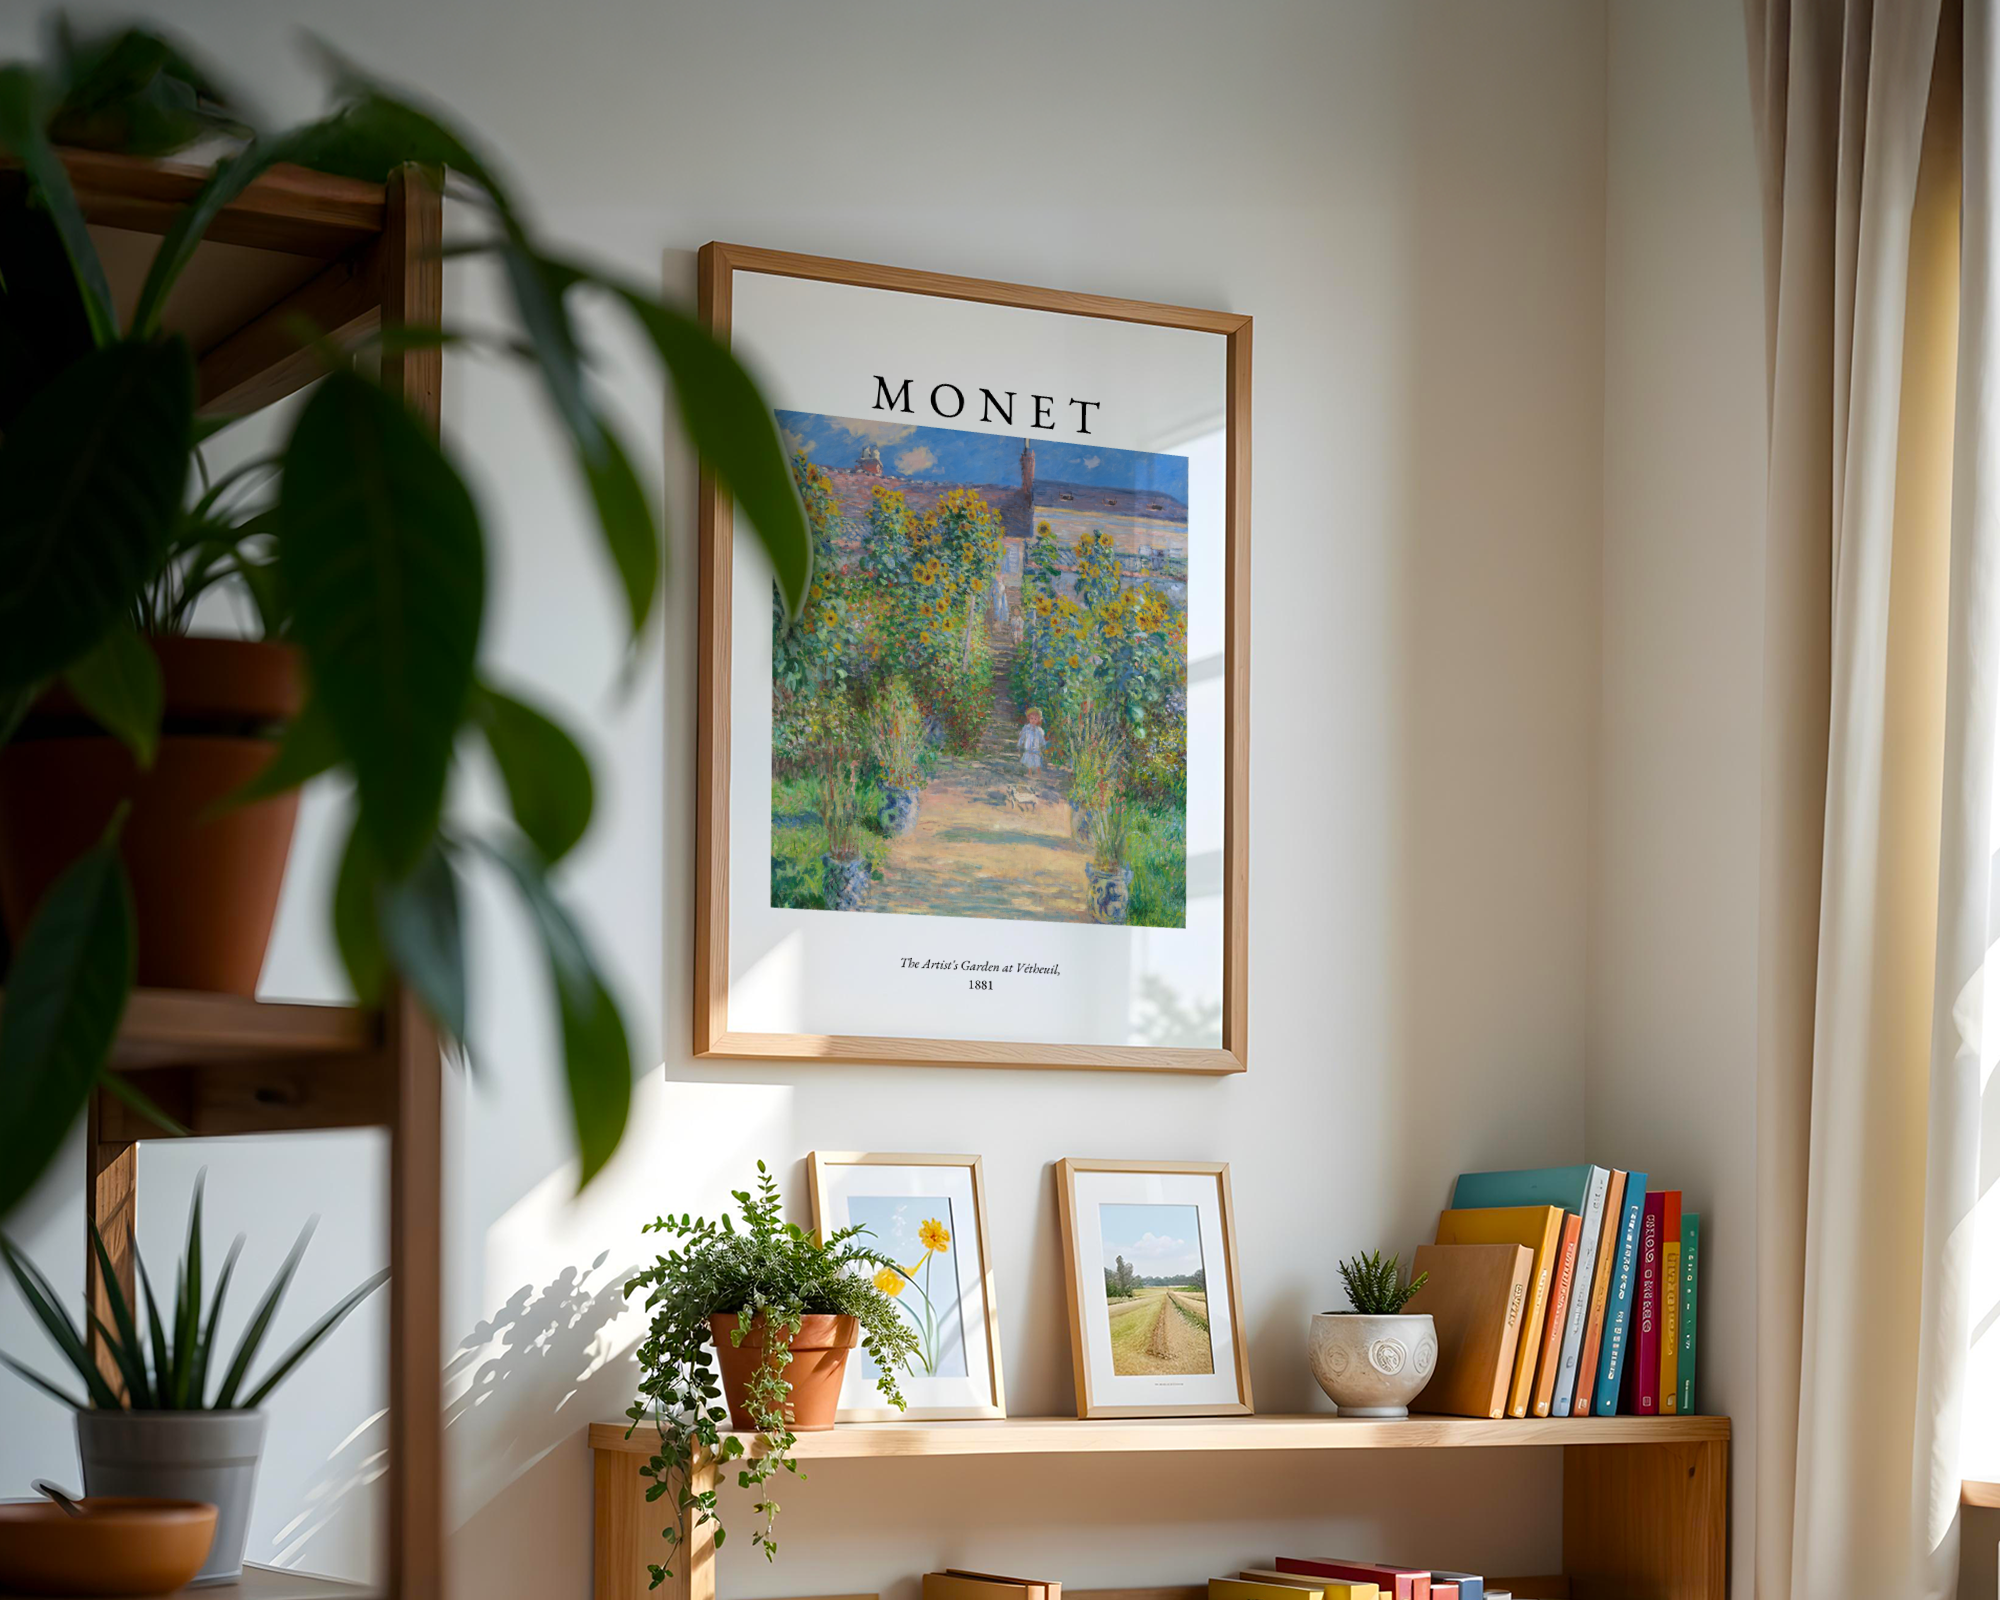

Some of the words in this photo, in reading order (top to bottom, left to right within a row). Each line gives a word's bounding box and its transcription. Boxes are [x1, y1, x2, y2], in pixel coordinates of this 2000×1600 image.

[872, 375, 1100, 434] MONET
[900, 957, 920, 969] The
[920, 958, 959, 971] Artist's
[960, 960, 1000, 972] Garden
[1001, 964, 1014, 973] at
[1016, 962, 1061, 977] Vétheuil,
[968, 979, 994, 991] 1881
